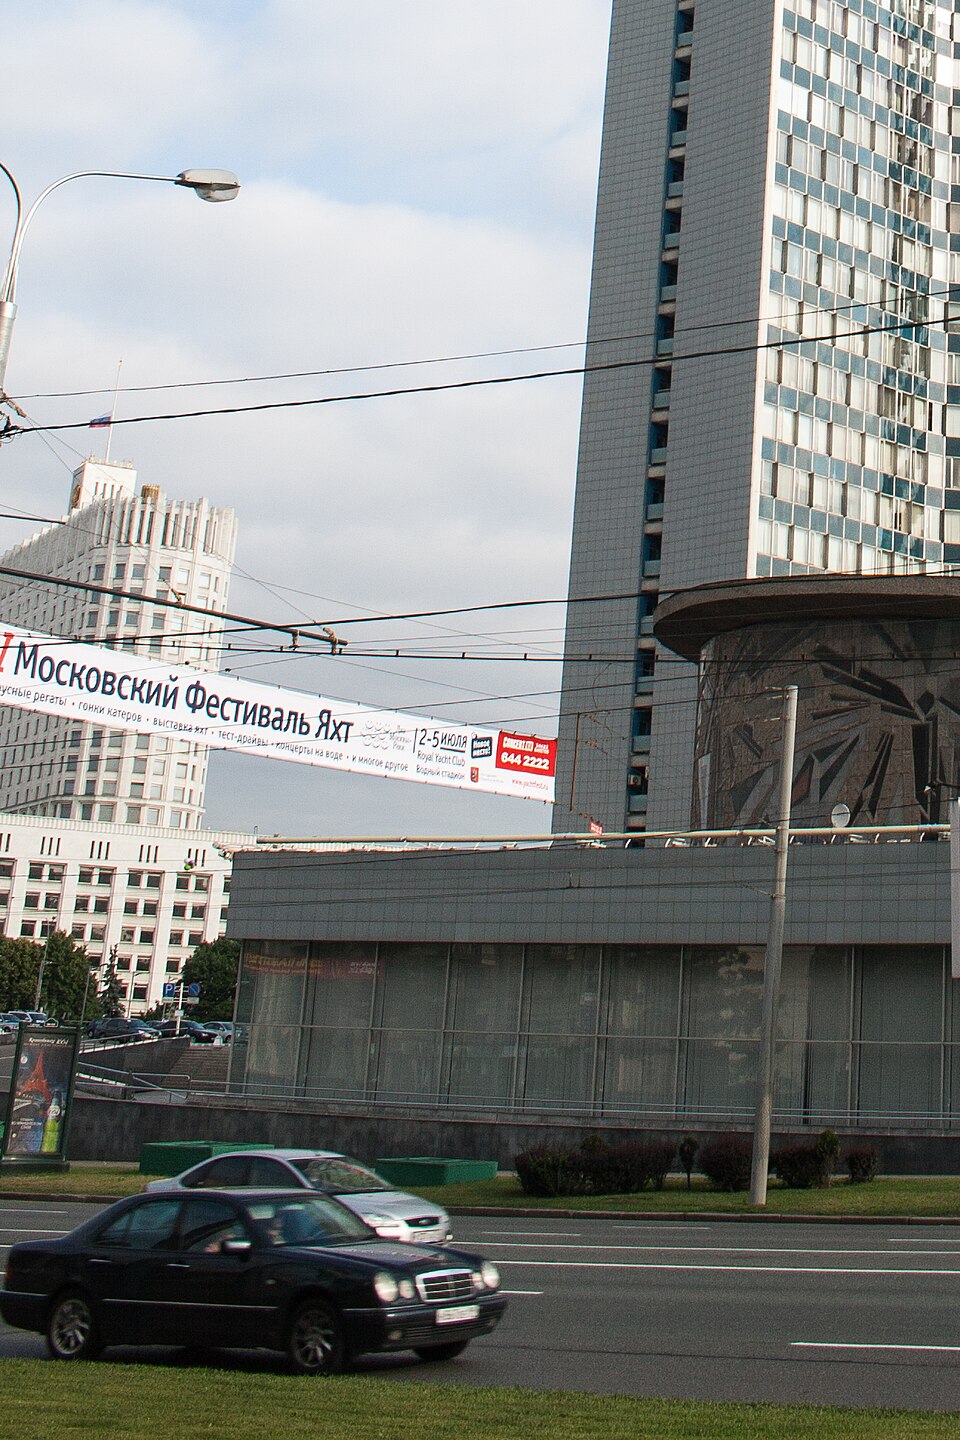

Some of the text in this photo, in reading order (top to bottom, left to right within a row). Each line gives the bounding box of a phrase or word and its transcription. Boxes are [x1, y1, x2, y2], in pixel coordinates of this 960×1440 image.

[14, 641, 354, 743] Московский Фестиваль Яхт
[33, 691, 67, 707] регаты
[78, 701, 105, 715] гонки
[107, 707, 142, 723] катеров
[153, 717, 192, 734] выставка
[218, 730, 269, 748] тест-драйвы
[276, 741, 313, 759] концерты
[315, 749, 323, 757] на
[325, 750, 343, 761] воде
[358, 757, 383, 768] многое
[385, 761, 409, 773] другое
[419, 728, 439, 748] 2-5
[417, 750, 466, 767] Royal Yacht Club
[501, 752, 550, 770] 644 2222
[416, 764, 441, 776] Водный
